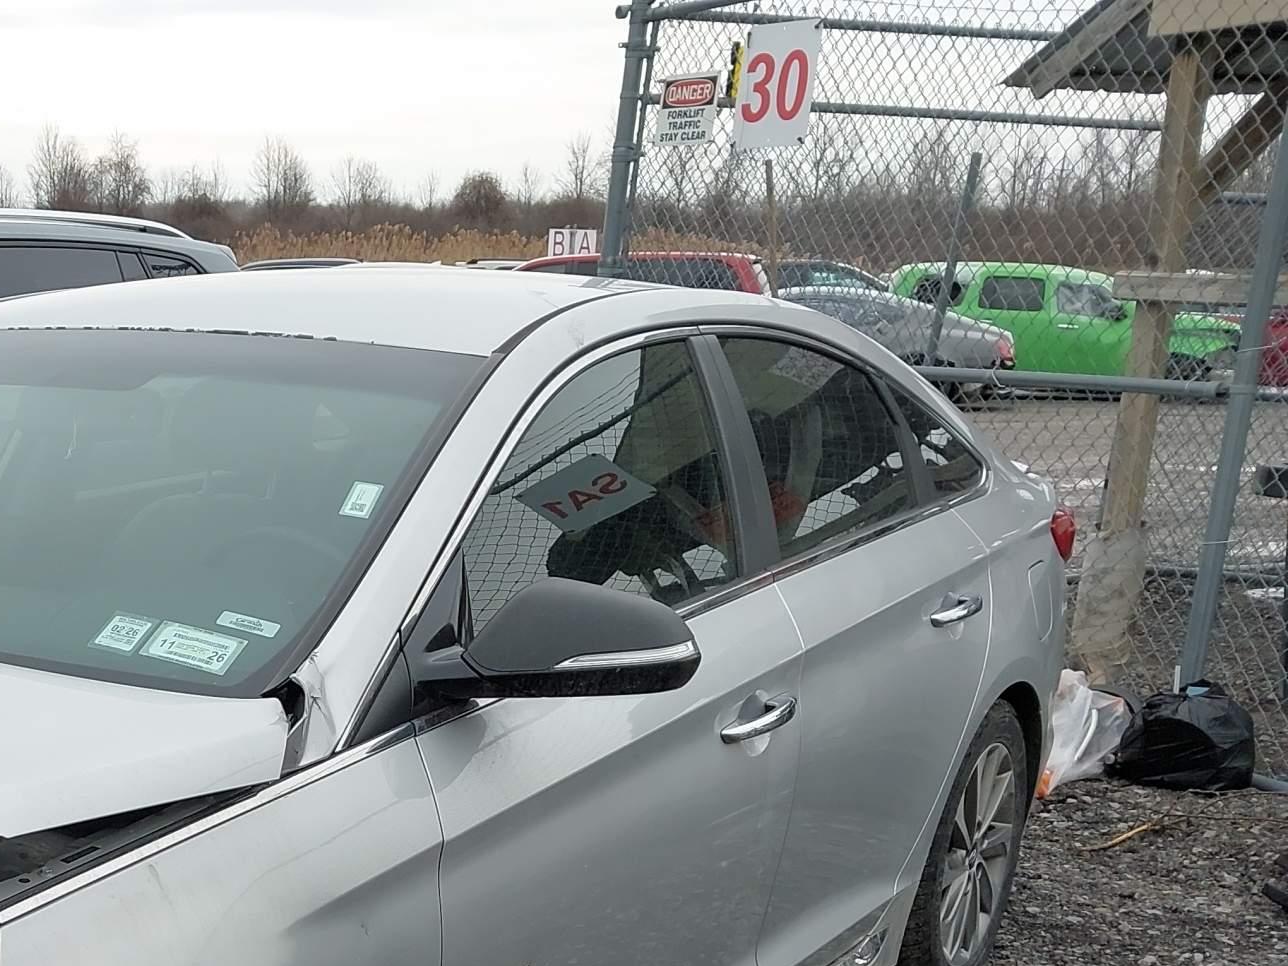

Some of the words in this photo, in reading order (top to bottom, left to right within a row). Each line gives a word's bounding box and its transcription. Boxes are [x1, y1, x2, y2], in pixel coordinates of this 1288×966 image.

[740, 49, 809, 123] 30
[668, 84, 712, 102] DANGER
[667, 108, 706, 120] FORKLIFT
[668, 120, 701, 130] TRAFFIC
[660, 132, 679, 142] STAY
[681, 130, 706, 141] CLEAR
[159, 638, 176, 650] 11
[207, 650, 227, 663] 26
